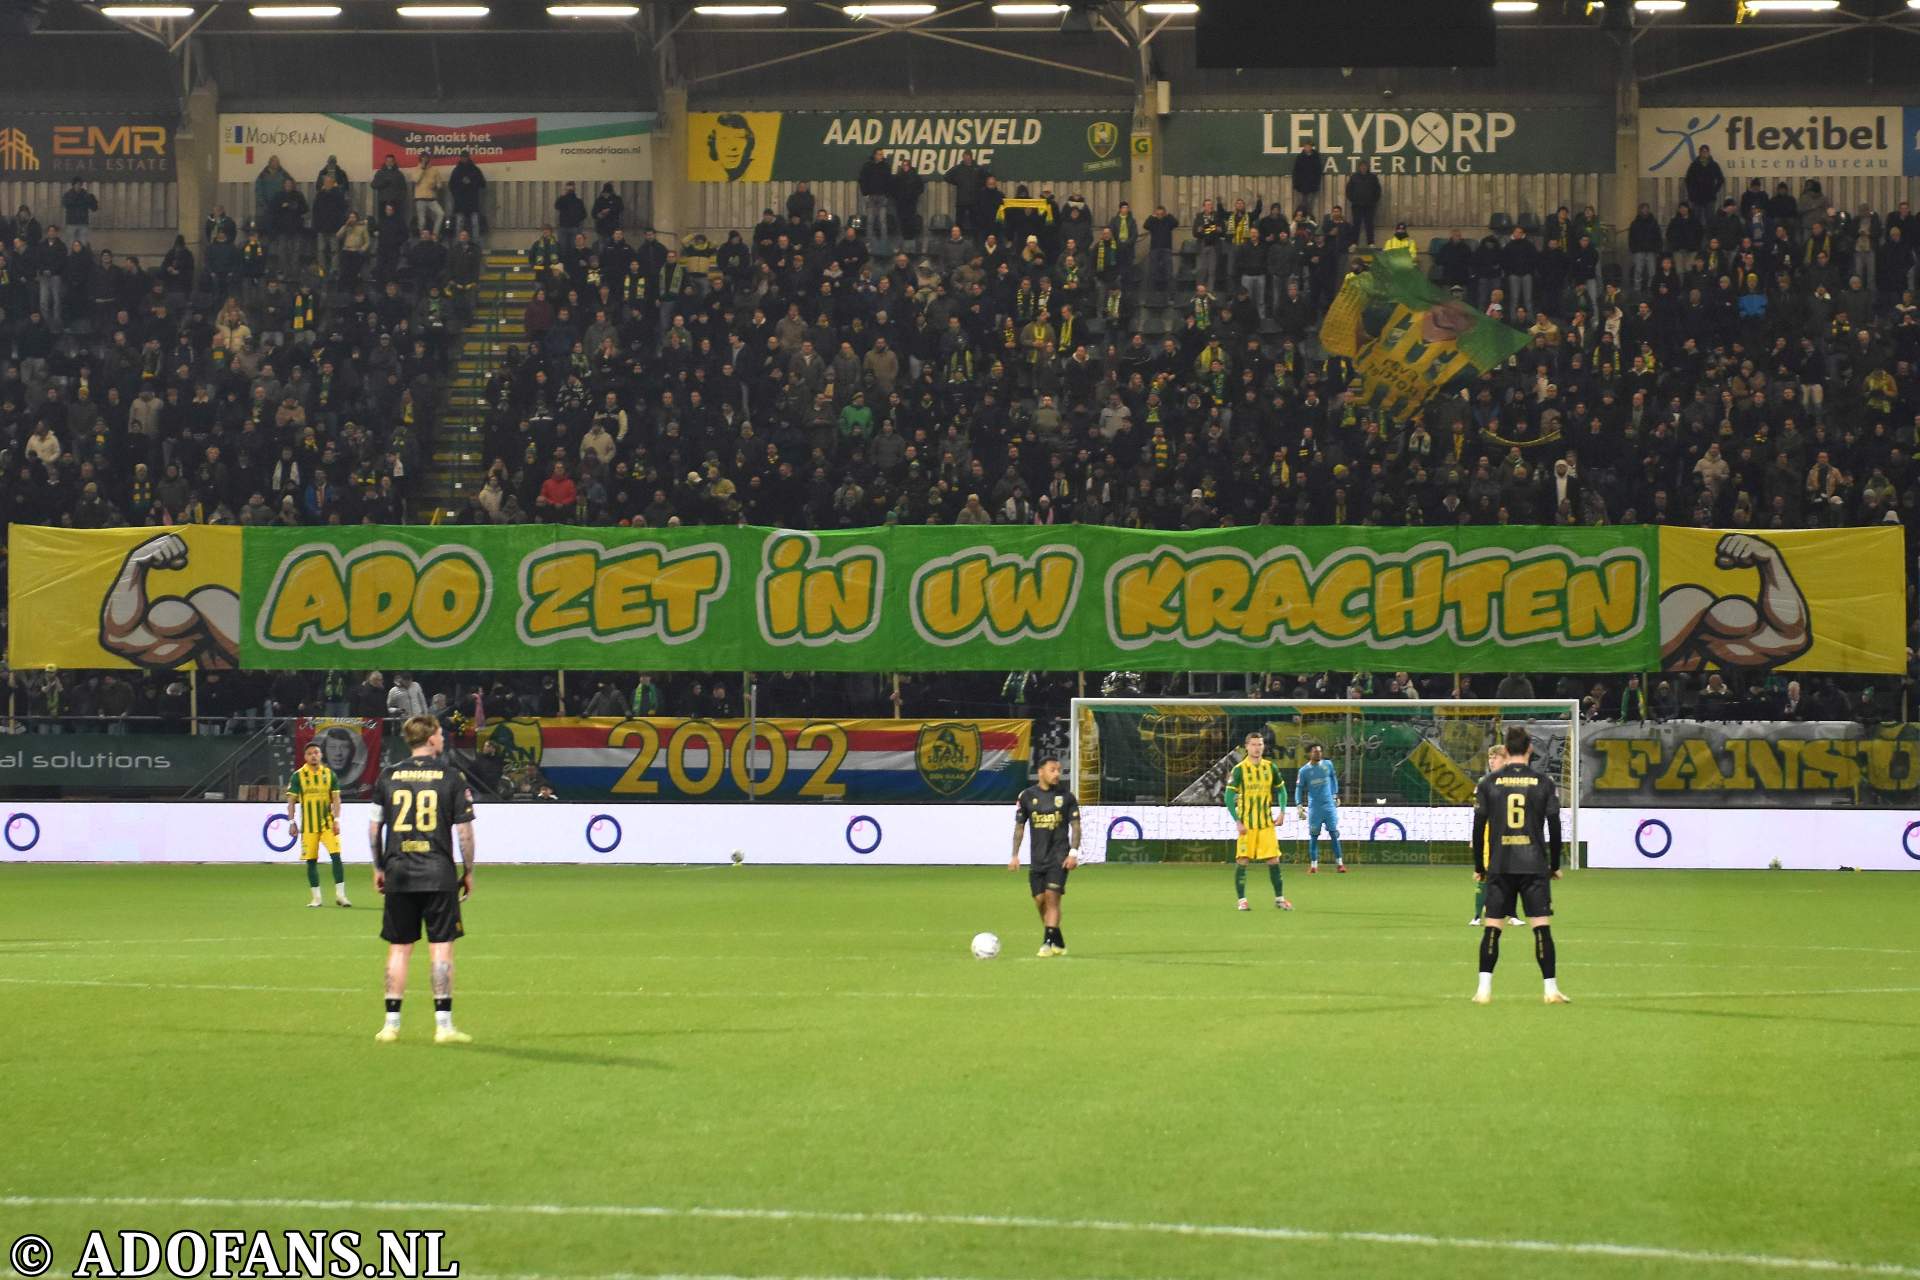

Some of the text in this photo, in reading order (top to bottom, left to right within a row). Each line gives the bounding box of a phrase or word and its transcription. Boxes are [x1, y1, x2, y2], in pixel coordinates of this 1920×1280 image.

[52, 126, 166, 155] EMR
[405, 132, 491, 143] Je maakt het
[823, 118, 1042, 145] AAD MANSVELD
[1725, 115, 1888, 150] flexibel
[560, 145, 641, 155] rocmondriaan.nl
[1135, 139, 1149, 153] G
[53, 159, 168, 170] REAL ESTATE
[1322, 156, 1472, 173] ATERING
[1727, 155, 1889, 169] uitzendbureau
[260, 544, 489, 647] ADO
[518, 543, 727, 643] ZET
[912, 546, 1081, 644] UW
[1106, 544, 1646, 647] KRACHTEN
[32, 751, 171, 768] solutions
[607, 720, 849, 796] 2002
[392, 789, 438, 832] 28
[1507, 793, 1526, 829] 6
